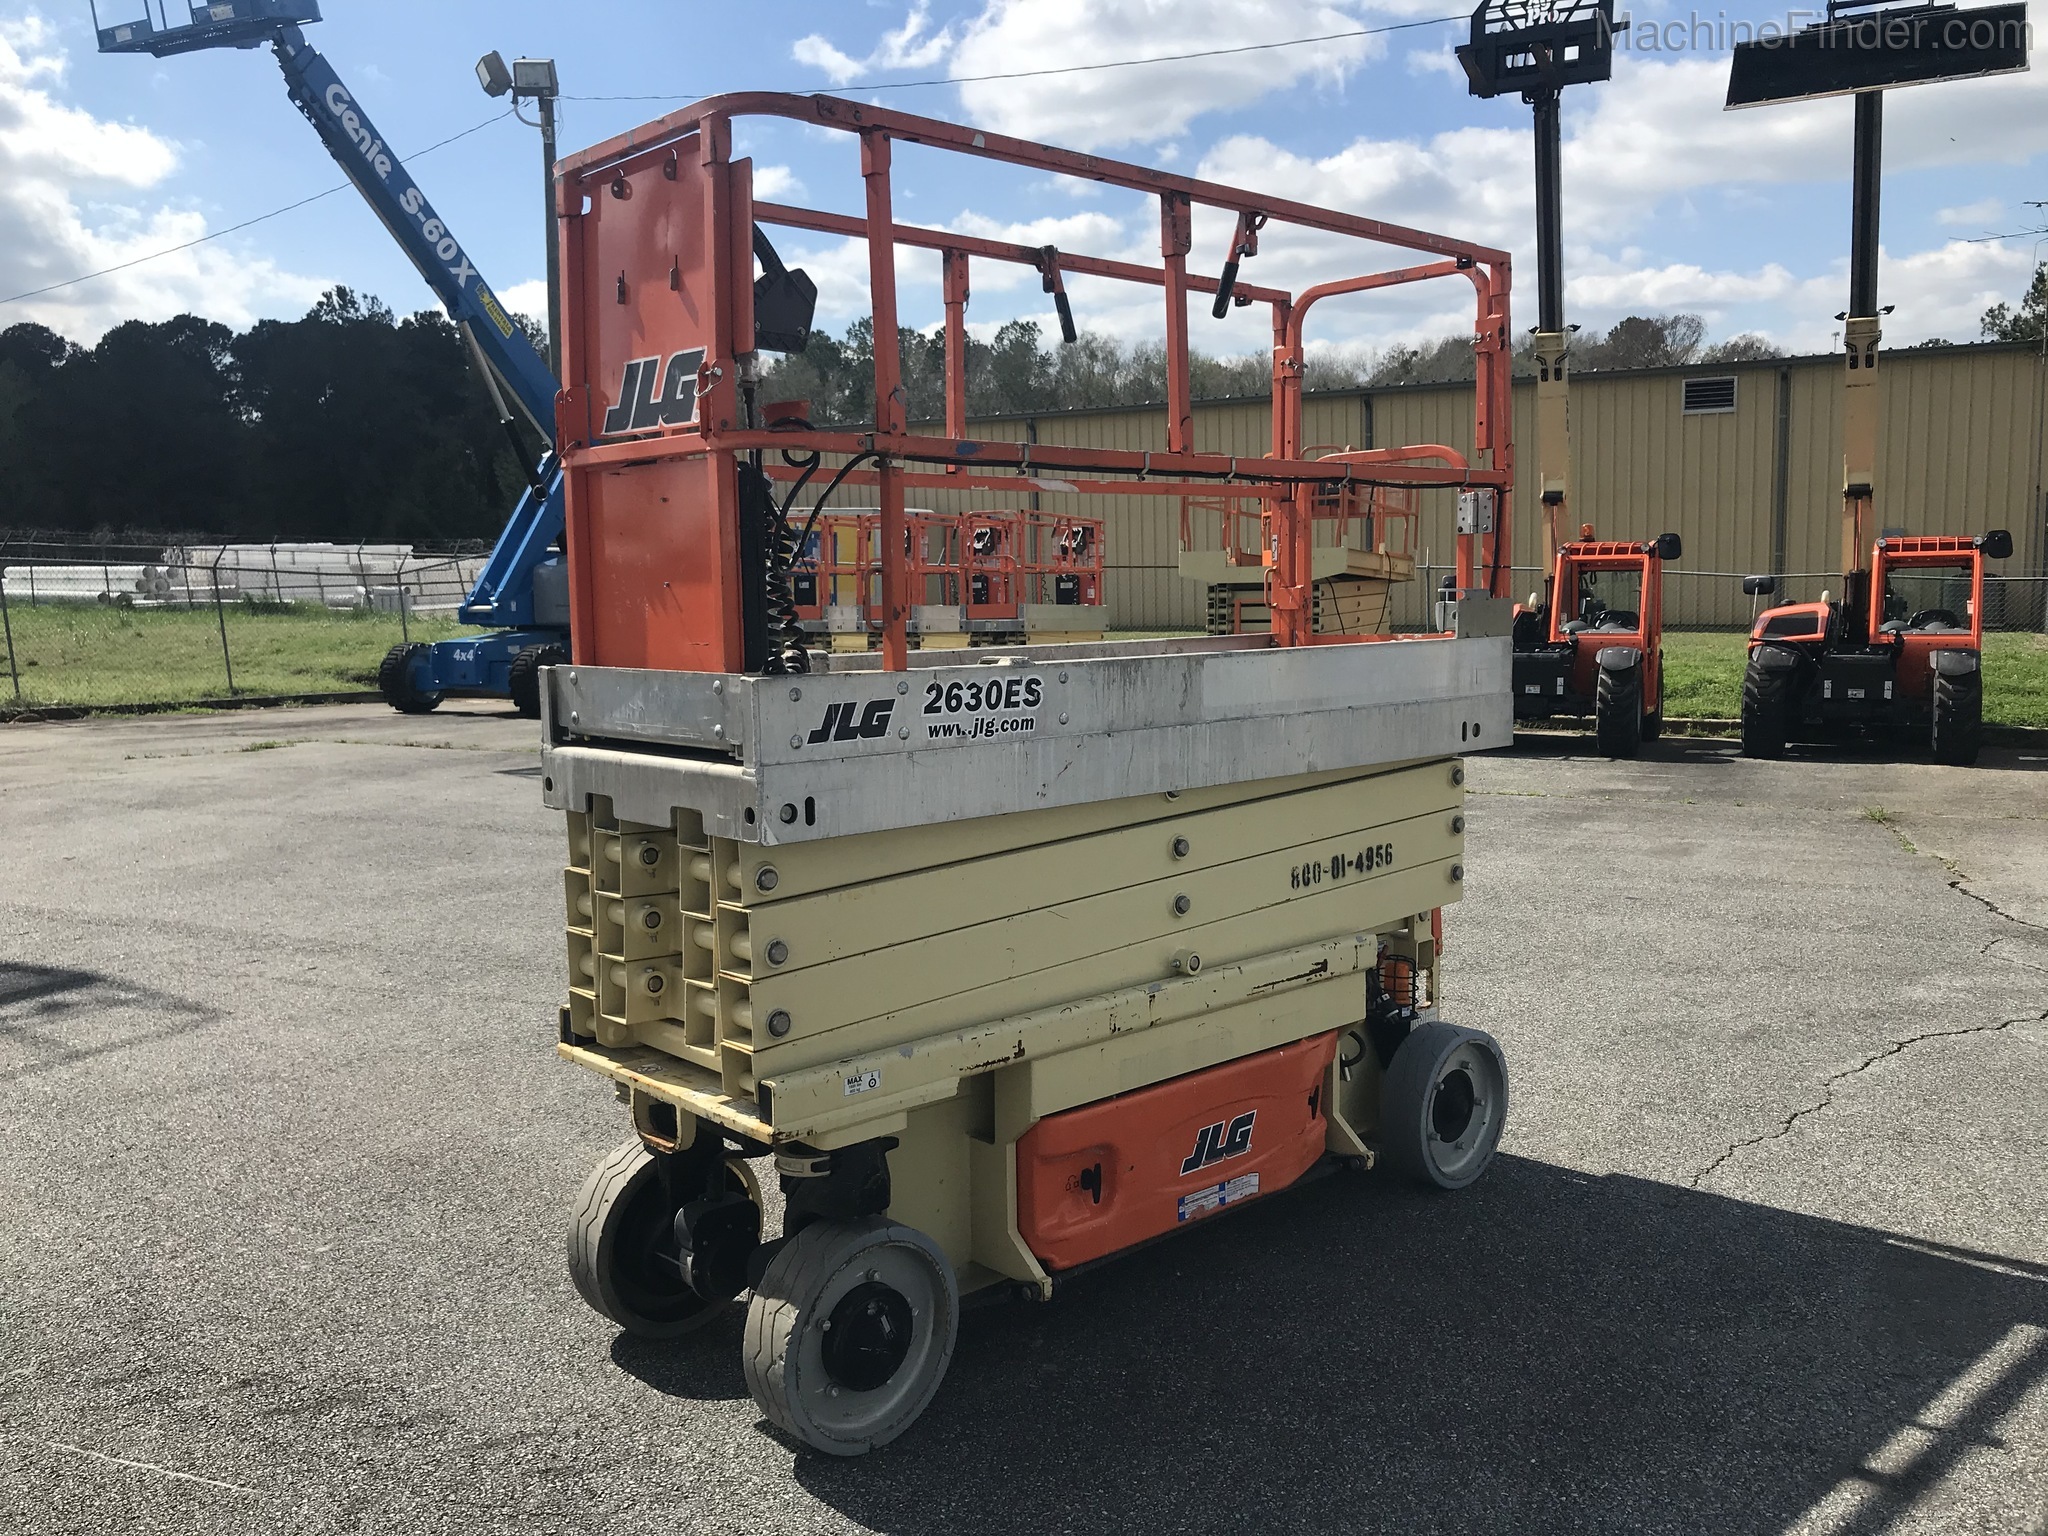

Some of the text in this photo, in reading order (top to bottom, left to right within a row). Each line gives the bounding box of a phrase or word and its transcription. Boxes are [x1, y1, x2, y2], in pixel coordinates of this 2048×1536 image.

[1526, 5, 1560, 26] Pro
[325, 83, 392, 181] Genie
[602, 347, 706, 434] JLG
[453, 649, 474, 661] 4x4
[923, 678, 1042, 714] 2630ES
[807, 699, 896, 744] JLG
[847, 1076, 862, 1085] MAX
[1180, 1110, 1257, 1176] JLG
